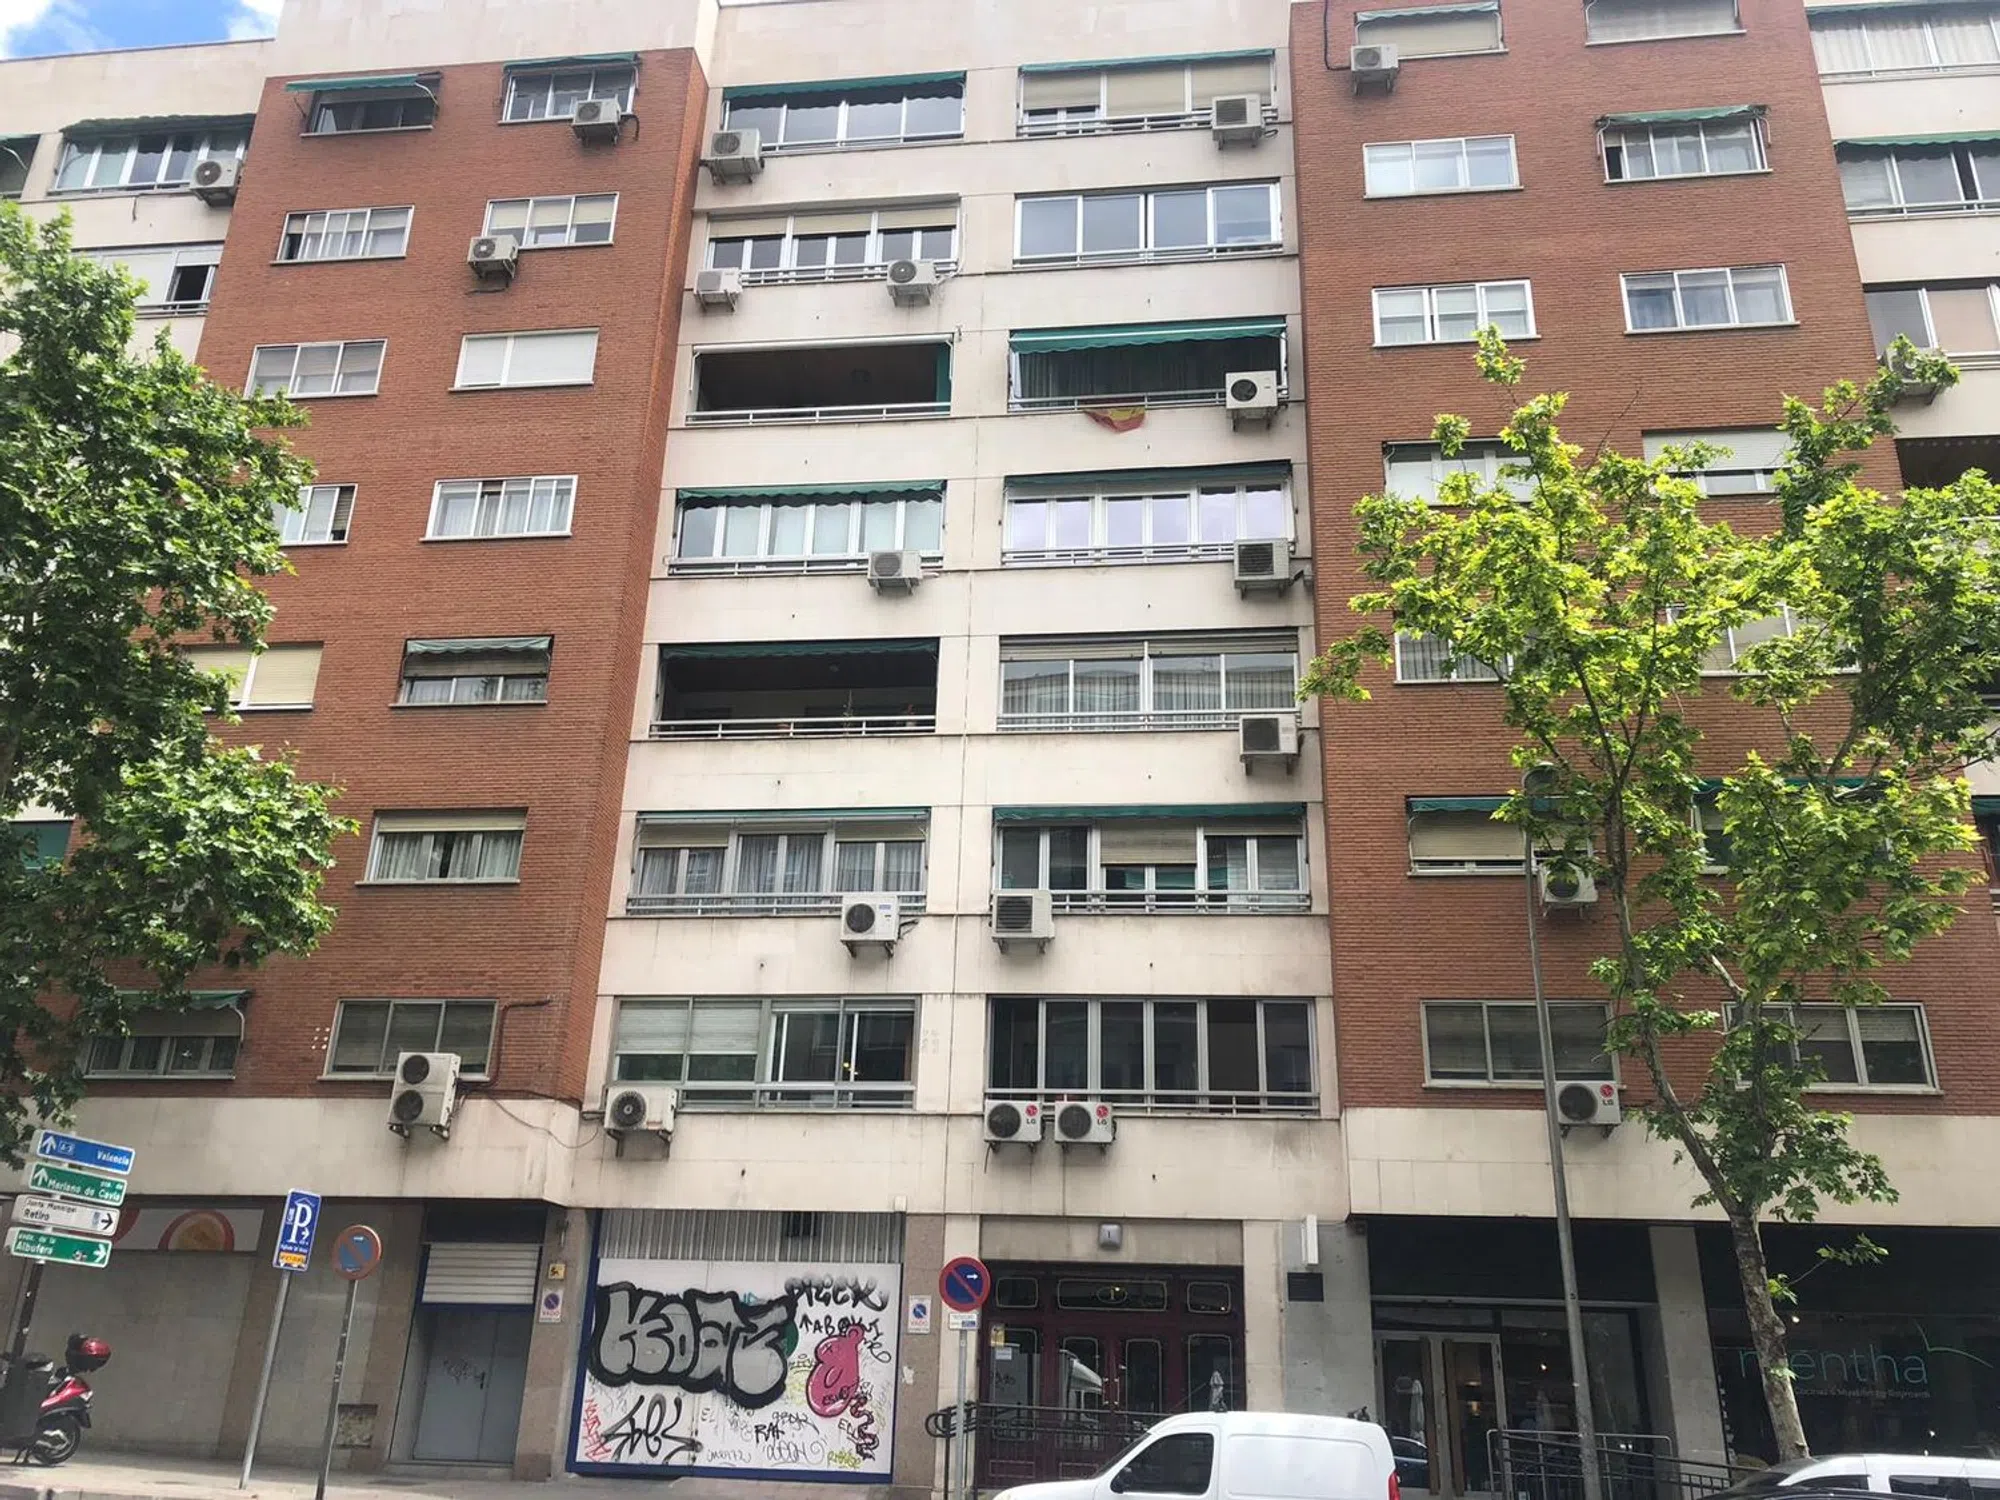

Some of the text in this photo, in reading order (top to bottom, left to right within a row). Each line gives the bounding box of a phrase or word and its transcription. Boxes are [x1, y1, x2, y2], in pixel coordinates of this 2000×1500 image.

[97, 1150, 129, 1165] Valencia
[48, 1179, 120, 1201] Mariano de Cavia
[24, 1208, 50, 1221] Retiro
[286, 1202, 312, 1243] P
[15, 1241, 54, 1255] Albufera
